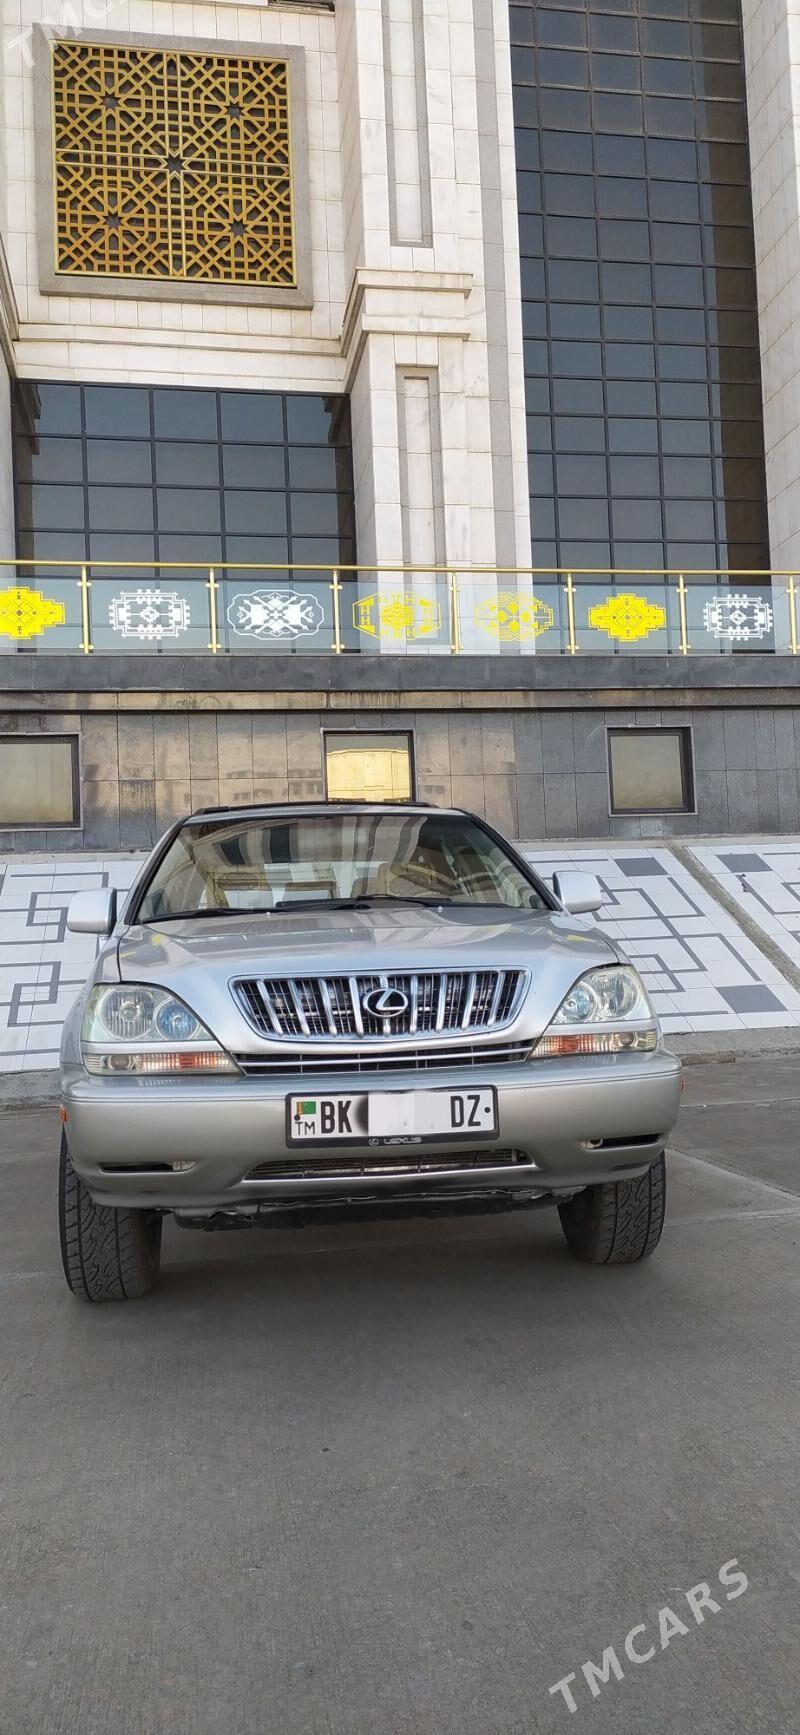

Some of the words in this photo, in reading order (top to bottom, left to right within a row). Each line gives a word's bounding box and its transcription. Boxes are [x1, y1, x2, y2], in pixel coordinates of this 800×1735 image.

[320, 1100, 352, 1134] BK
[450, 1094, 481, 1128] DZ
[294, 1120, 316, 1136] TM
[383, 1136, 422, 1145] LEXUS
